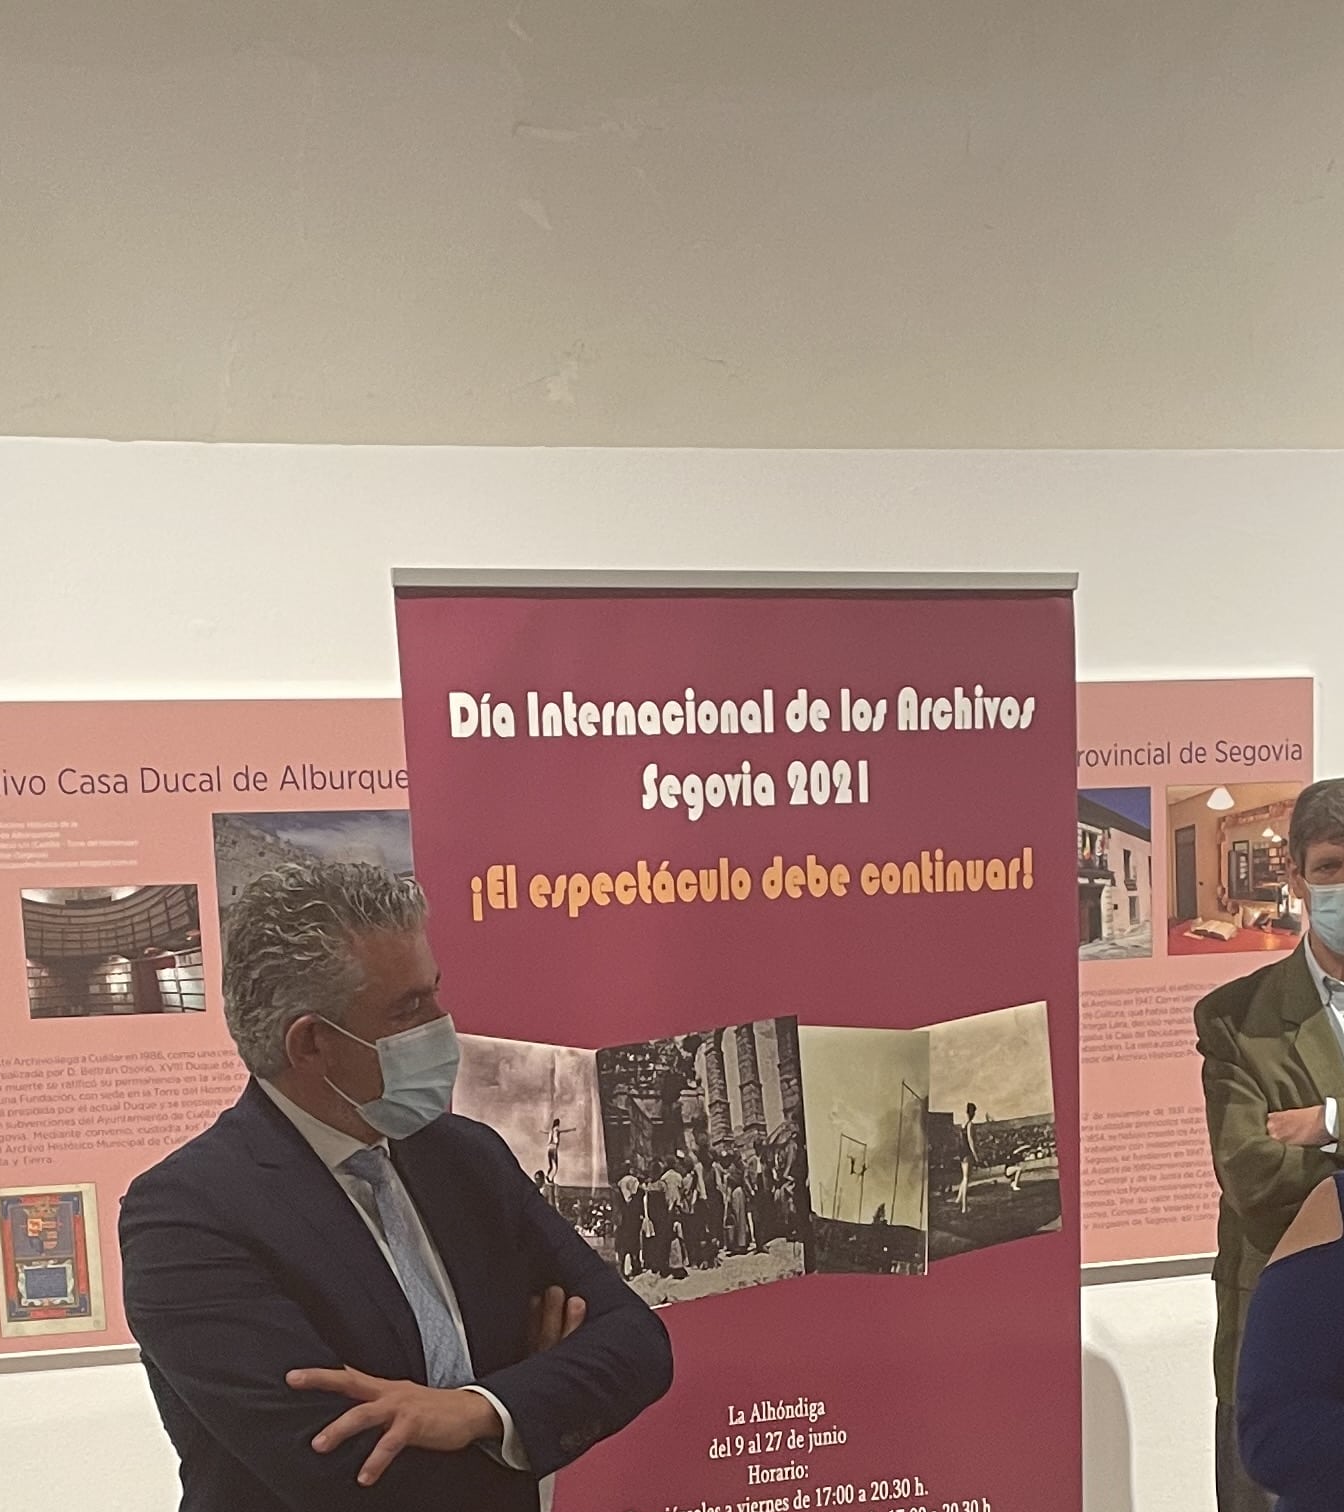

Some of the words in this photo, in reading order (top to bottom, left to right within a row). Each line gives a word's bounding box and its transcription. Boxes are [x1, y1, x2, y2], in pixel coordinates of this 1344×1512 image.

[449, 691, 515, 739] Día
[528, 687, 774, 738] Internacional
[785, 689, 830, 733] de
[841, 688, 887, 733] los
[897, 684, 1036, 731] Archivos
[1077, 741, 1171, 768] rovincial
[1179, 740, 1207, 764] de
[1215, 738, 1303, 767] Segovia
[58, 768, 128, 797] Casa
[141, 764, 221, 795] Ducal
[232, 763, 268, 793] de
[642, 761, 775, 821] Segovia
[787, 759, 870, 806] 2021
[471, 864, 517, 921] ¡El
[529, 857, 752, 918] espectáculo
[762, 853, 850, 900] debe
[860, 846, 1035, 896] continuar!
[727, 1405, 746, 1426] La
[749, 1396, 826, 1424] Alhóndiga
[709, 1437, 731, 1459] del
[735, 1435, 745, 1456] 9
[748, 1432, 762, 1454] al
[765, 1430, 783, 1452] 27
[787, 1427, 805, 1450] de
[807, 1424, 847, 1453] junio
[747, 1460, 809, 1485] Horario:
[793, 1488, 811, 1510] de
[815, 1483, 854, 1507] 17:00
[858, 1487, 867, 1502] a
[870, 1477, 911, 1501] 20.30
[914, 1476, 929, 1497] h.
